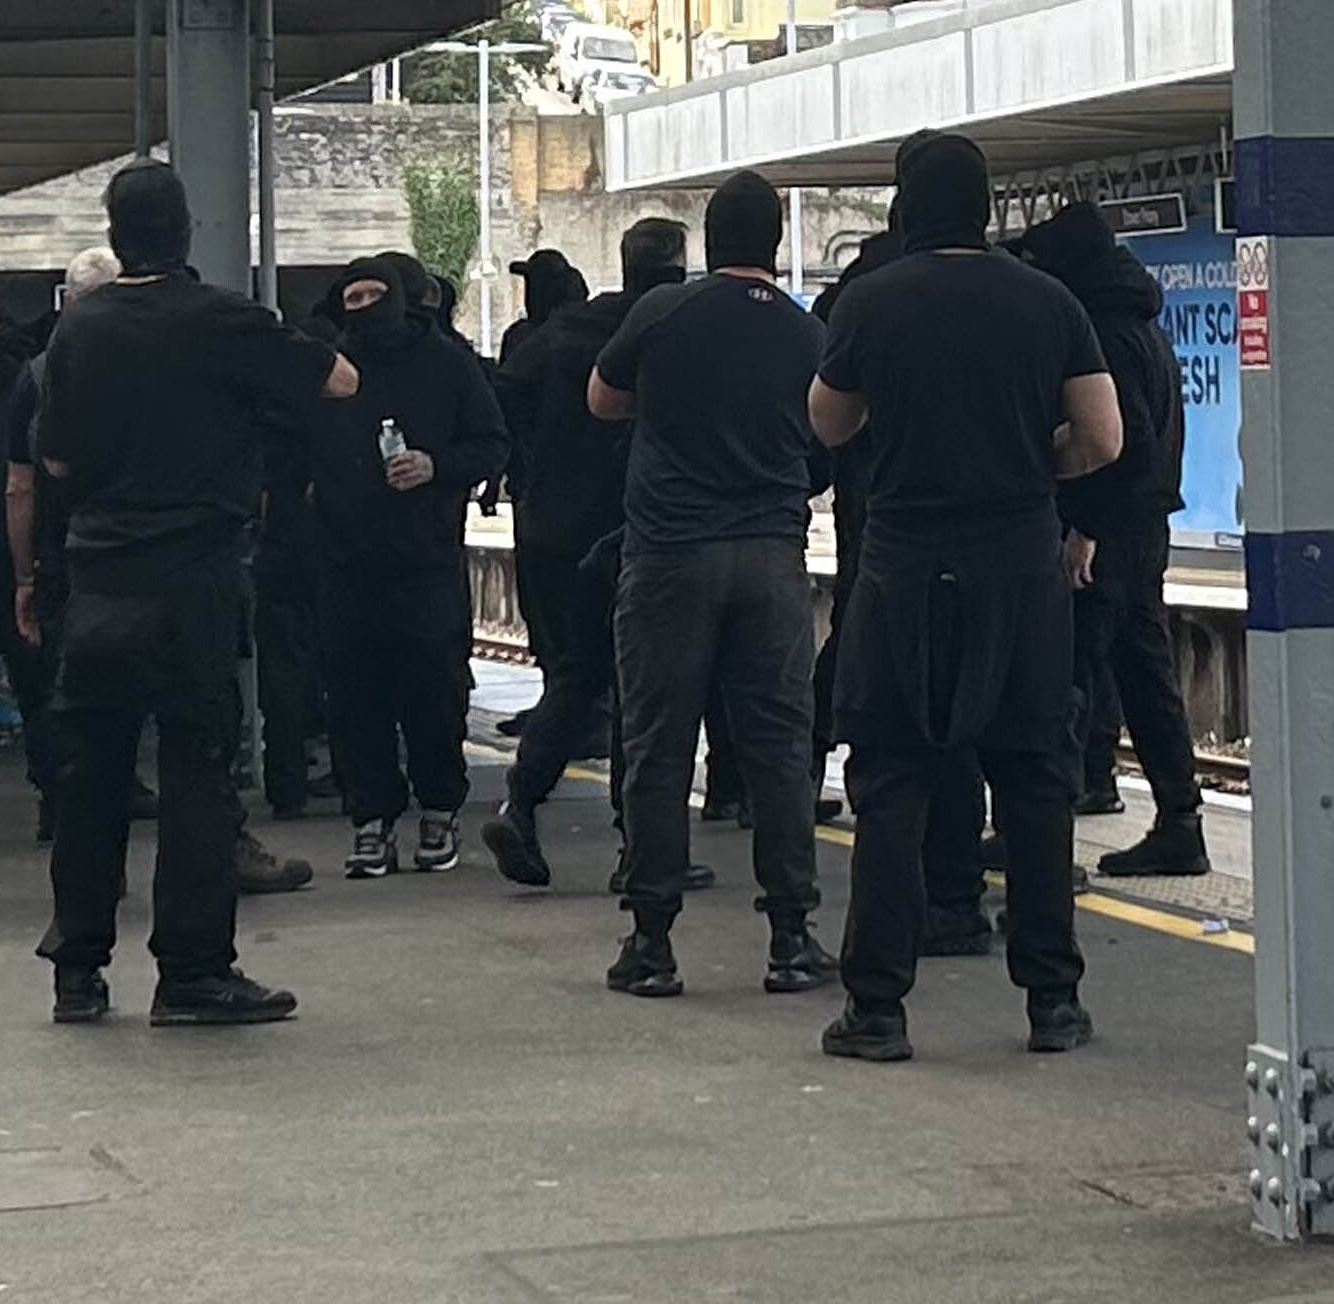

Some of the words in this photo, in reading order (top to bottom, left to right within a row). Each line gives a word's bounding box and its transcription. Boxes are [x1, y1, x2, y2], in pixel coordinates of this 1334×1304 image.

[1161, 263, 1194, 291] OPEN
[1163, 302, 1200, 346] ANT
[1179, 354, 1220, 405] ESH
